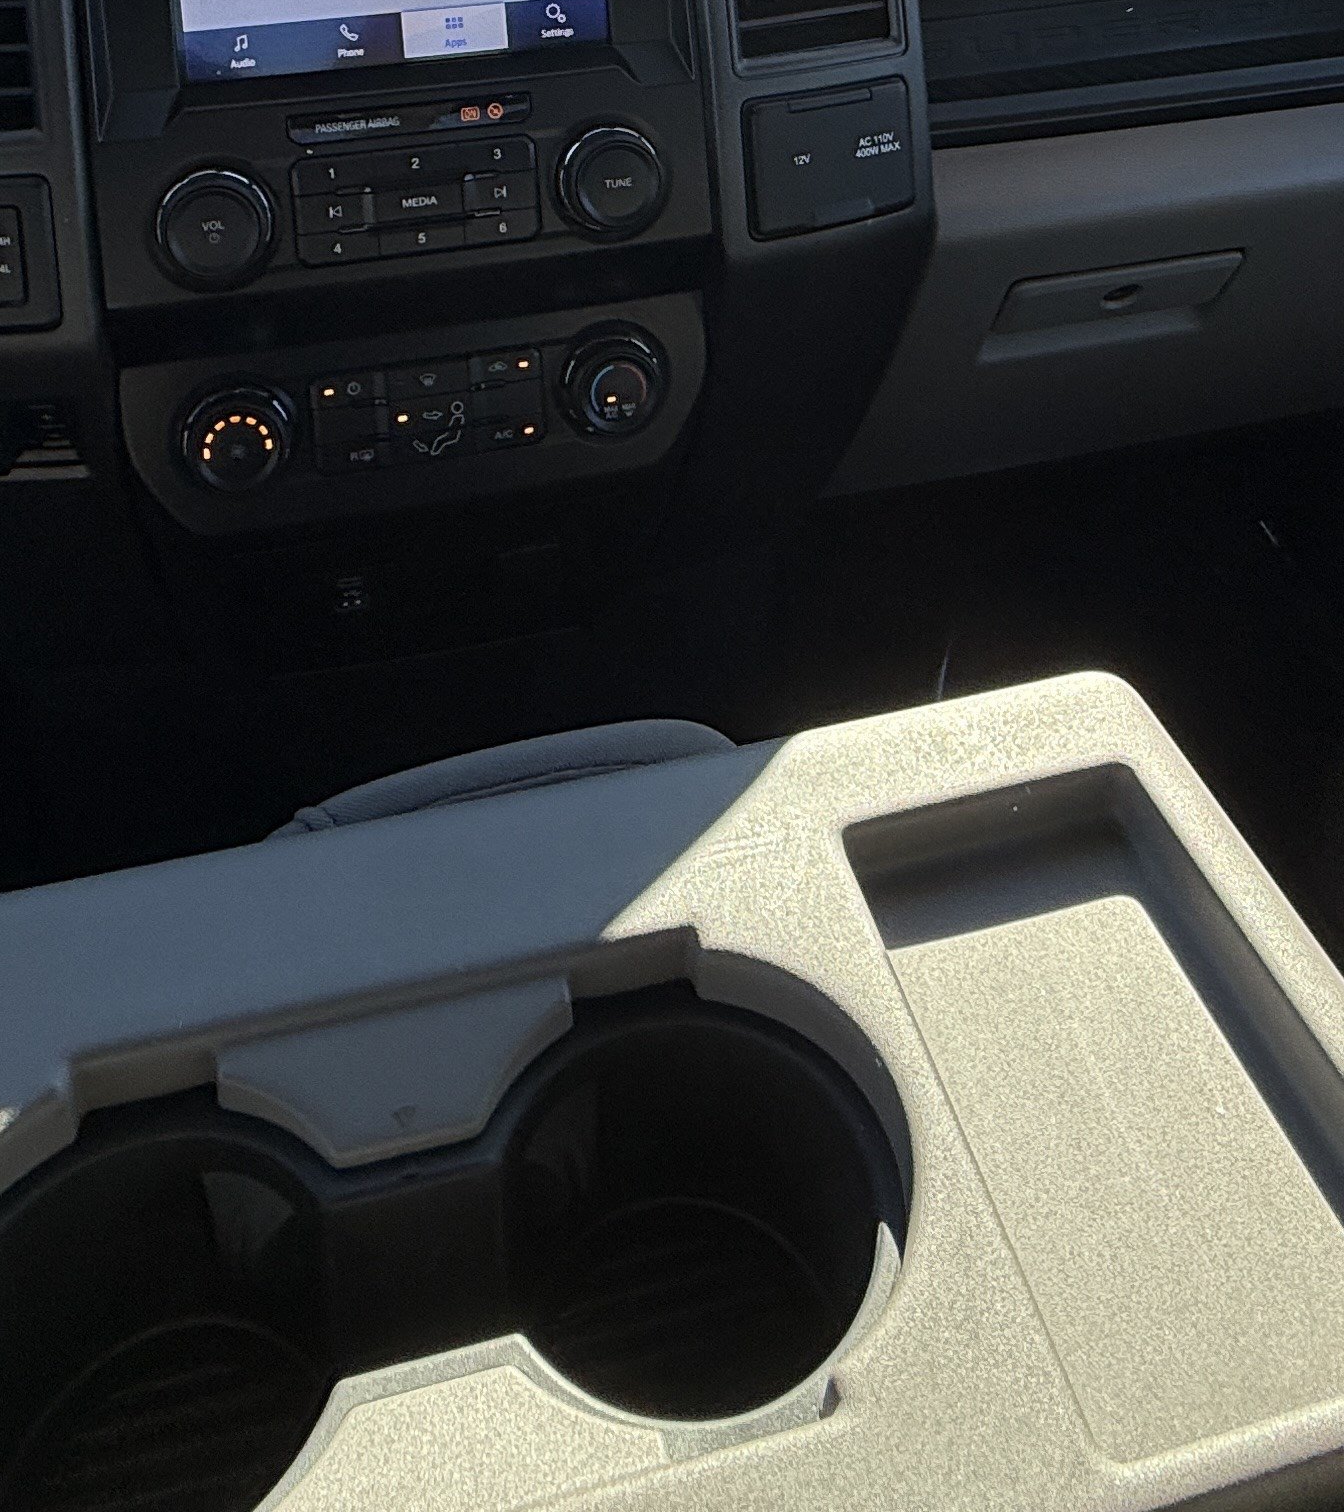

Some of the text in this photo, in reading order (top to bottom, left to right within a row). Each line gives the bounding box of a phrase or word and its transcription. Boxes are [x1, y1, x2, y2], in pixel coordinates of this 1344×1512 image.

[541, 27, 574, 39] Settings
[444, 37, 468, 49] Apps
[337, 46, 364, 58] Phone
[231, 57, 256, 69] Audio
[315, 116, 400, 134] PASSENGER AIRBAG
[858, 132, 894, 147] AC 110V
[492, 148, 502, 160] 3
[855, 141, 901, 158] 400W MAX
[410, 157, 421, 169] 2
[793, 153, 811, 165] 12V
[328, 167, 336, 179] 1
[604, 176, 632, 189] TUNE
[401, 196, 438, 208] MEDIA
[201, 219, 225, 232] VOL
[498, 221, 508, 234] 6
[417, 232, 426, 244] 5
[333, 242, 342, 253] 4
[494, 428, 513, 439] A/C
